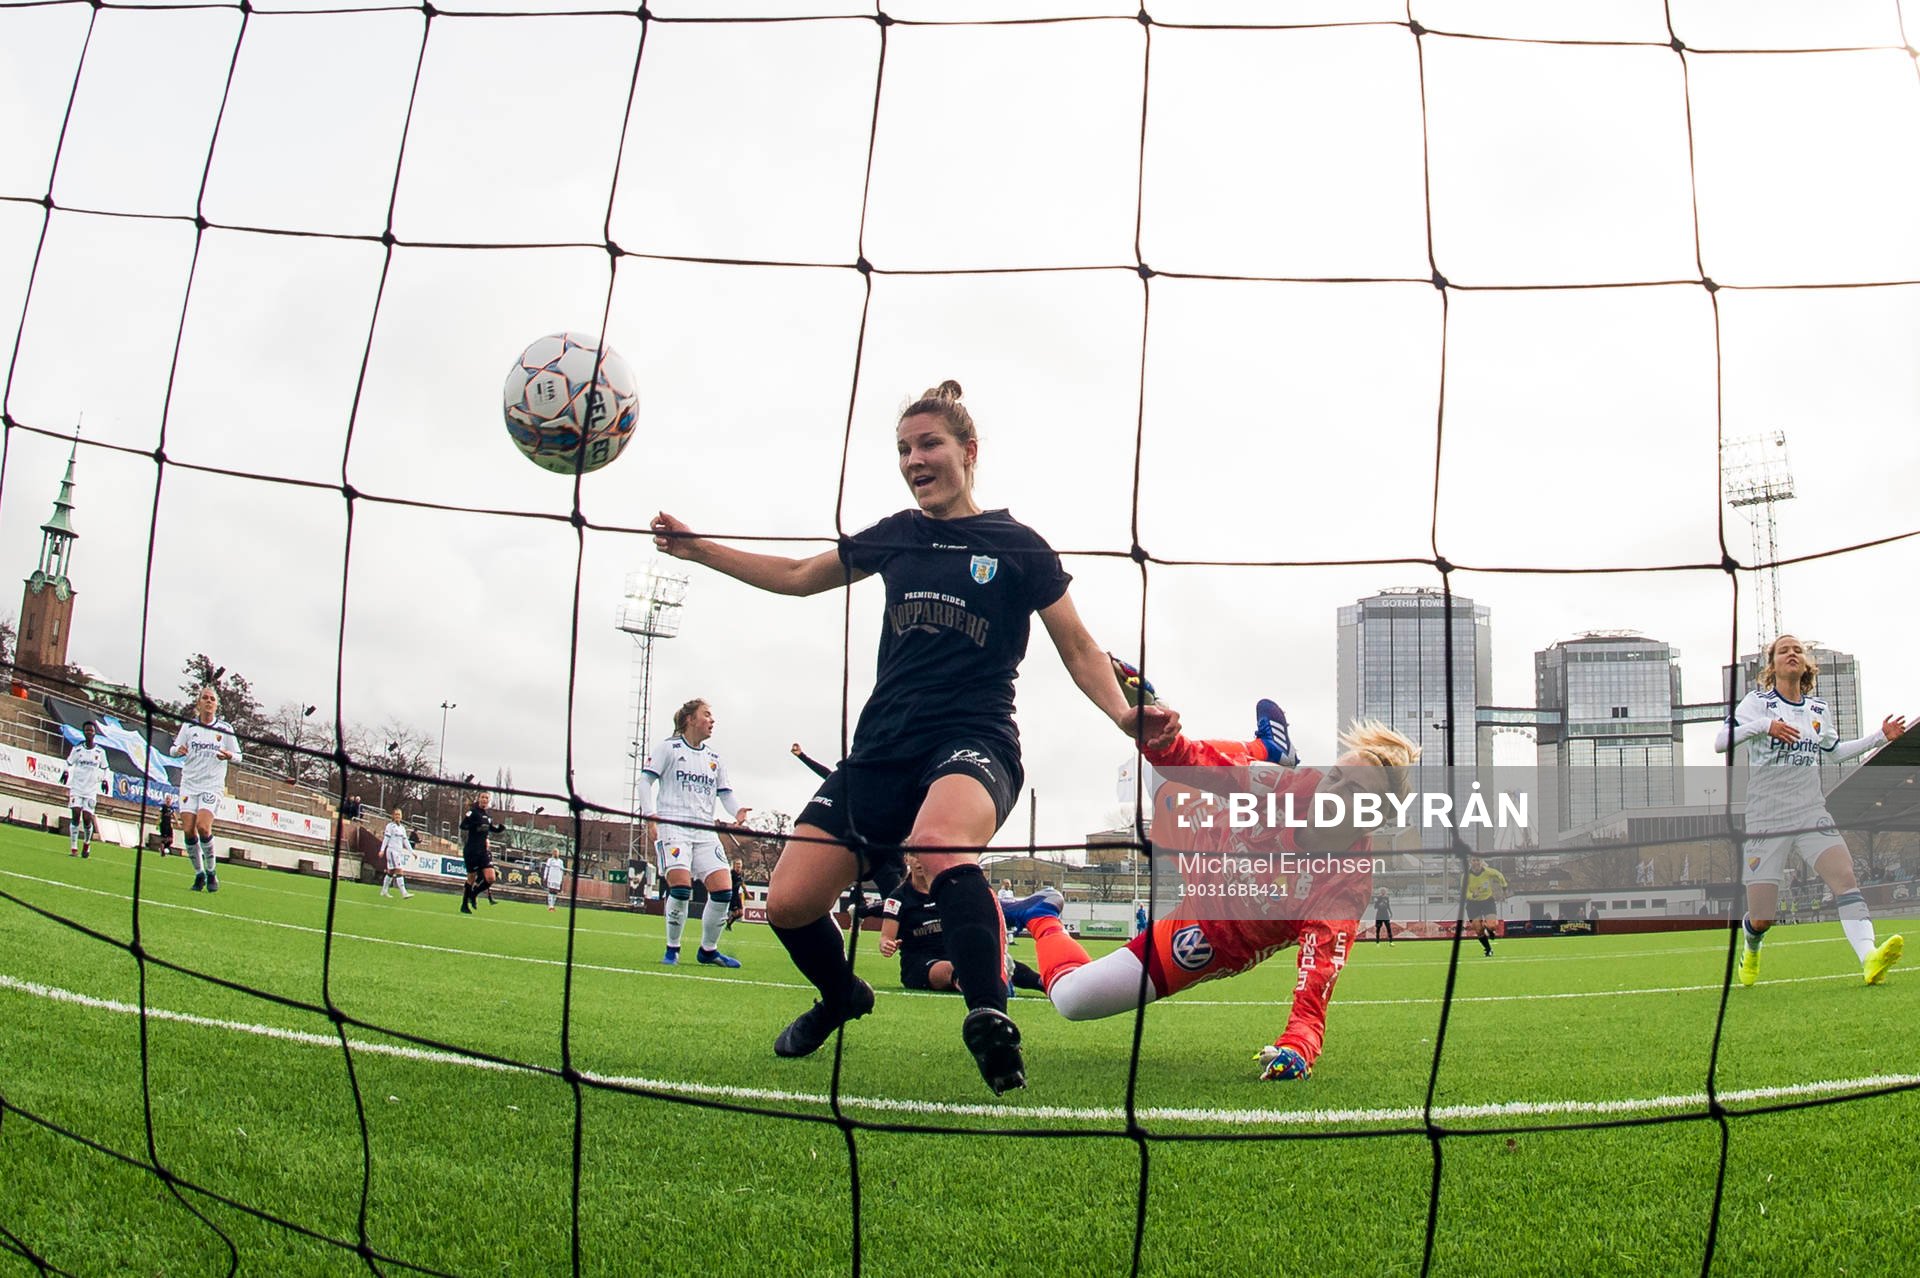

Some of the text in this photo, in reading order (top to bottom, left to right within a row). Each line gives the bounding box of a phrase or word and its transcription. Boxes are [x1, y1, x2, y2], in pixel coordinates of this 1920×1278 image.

[904, 591, 966, 607] PREMIUM CIDER
[1382, 599, 1457, 608] GOTHIA TOWES
[888, 601, 989, 648] KOPPARBERG
[130, 784, 163, 801] SVESKA
